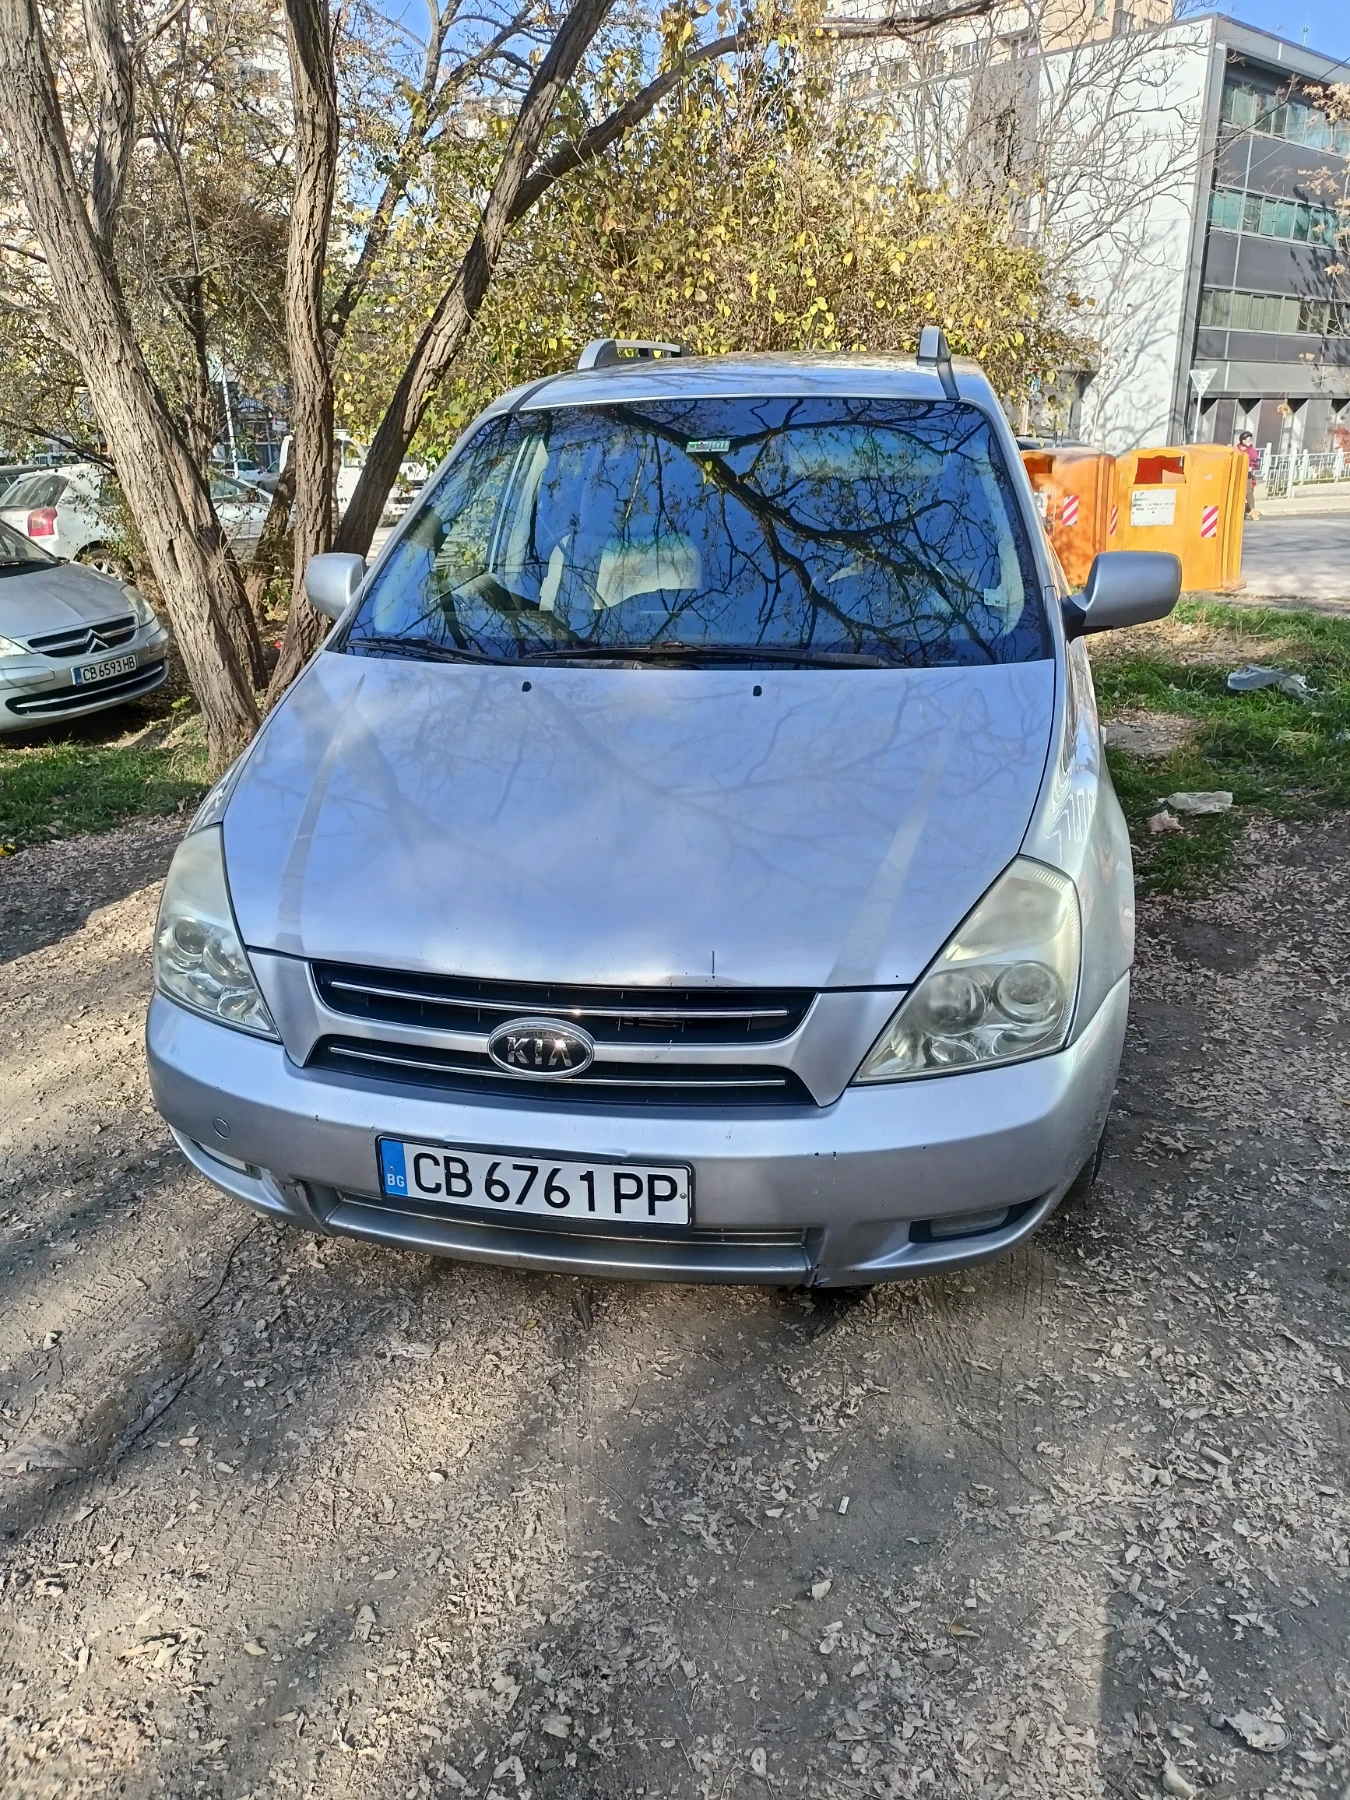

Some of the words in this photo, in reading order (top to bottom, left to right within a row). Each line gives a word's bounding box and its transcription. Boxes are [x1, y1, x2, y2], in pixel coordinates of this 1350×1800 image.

[83, 667, 97, 681] CB
[99, 660, 122, 677] 6593
[122, 656, 135, 671] HB
[506, 1036, 573, 1067] KIA
[387, 1173, 405, 1188] BG
[413, 1152, 473, 1198] CB
[484, 1161, 596, 1212] 6761
[613, 1172, 678, 1216] PP
